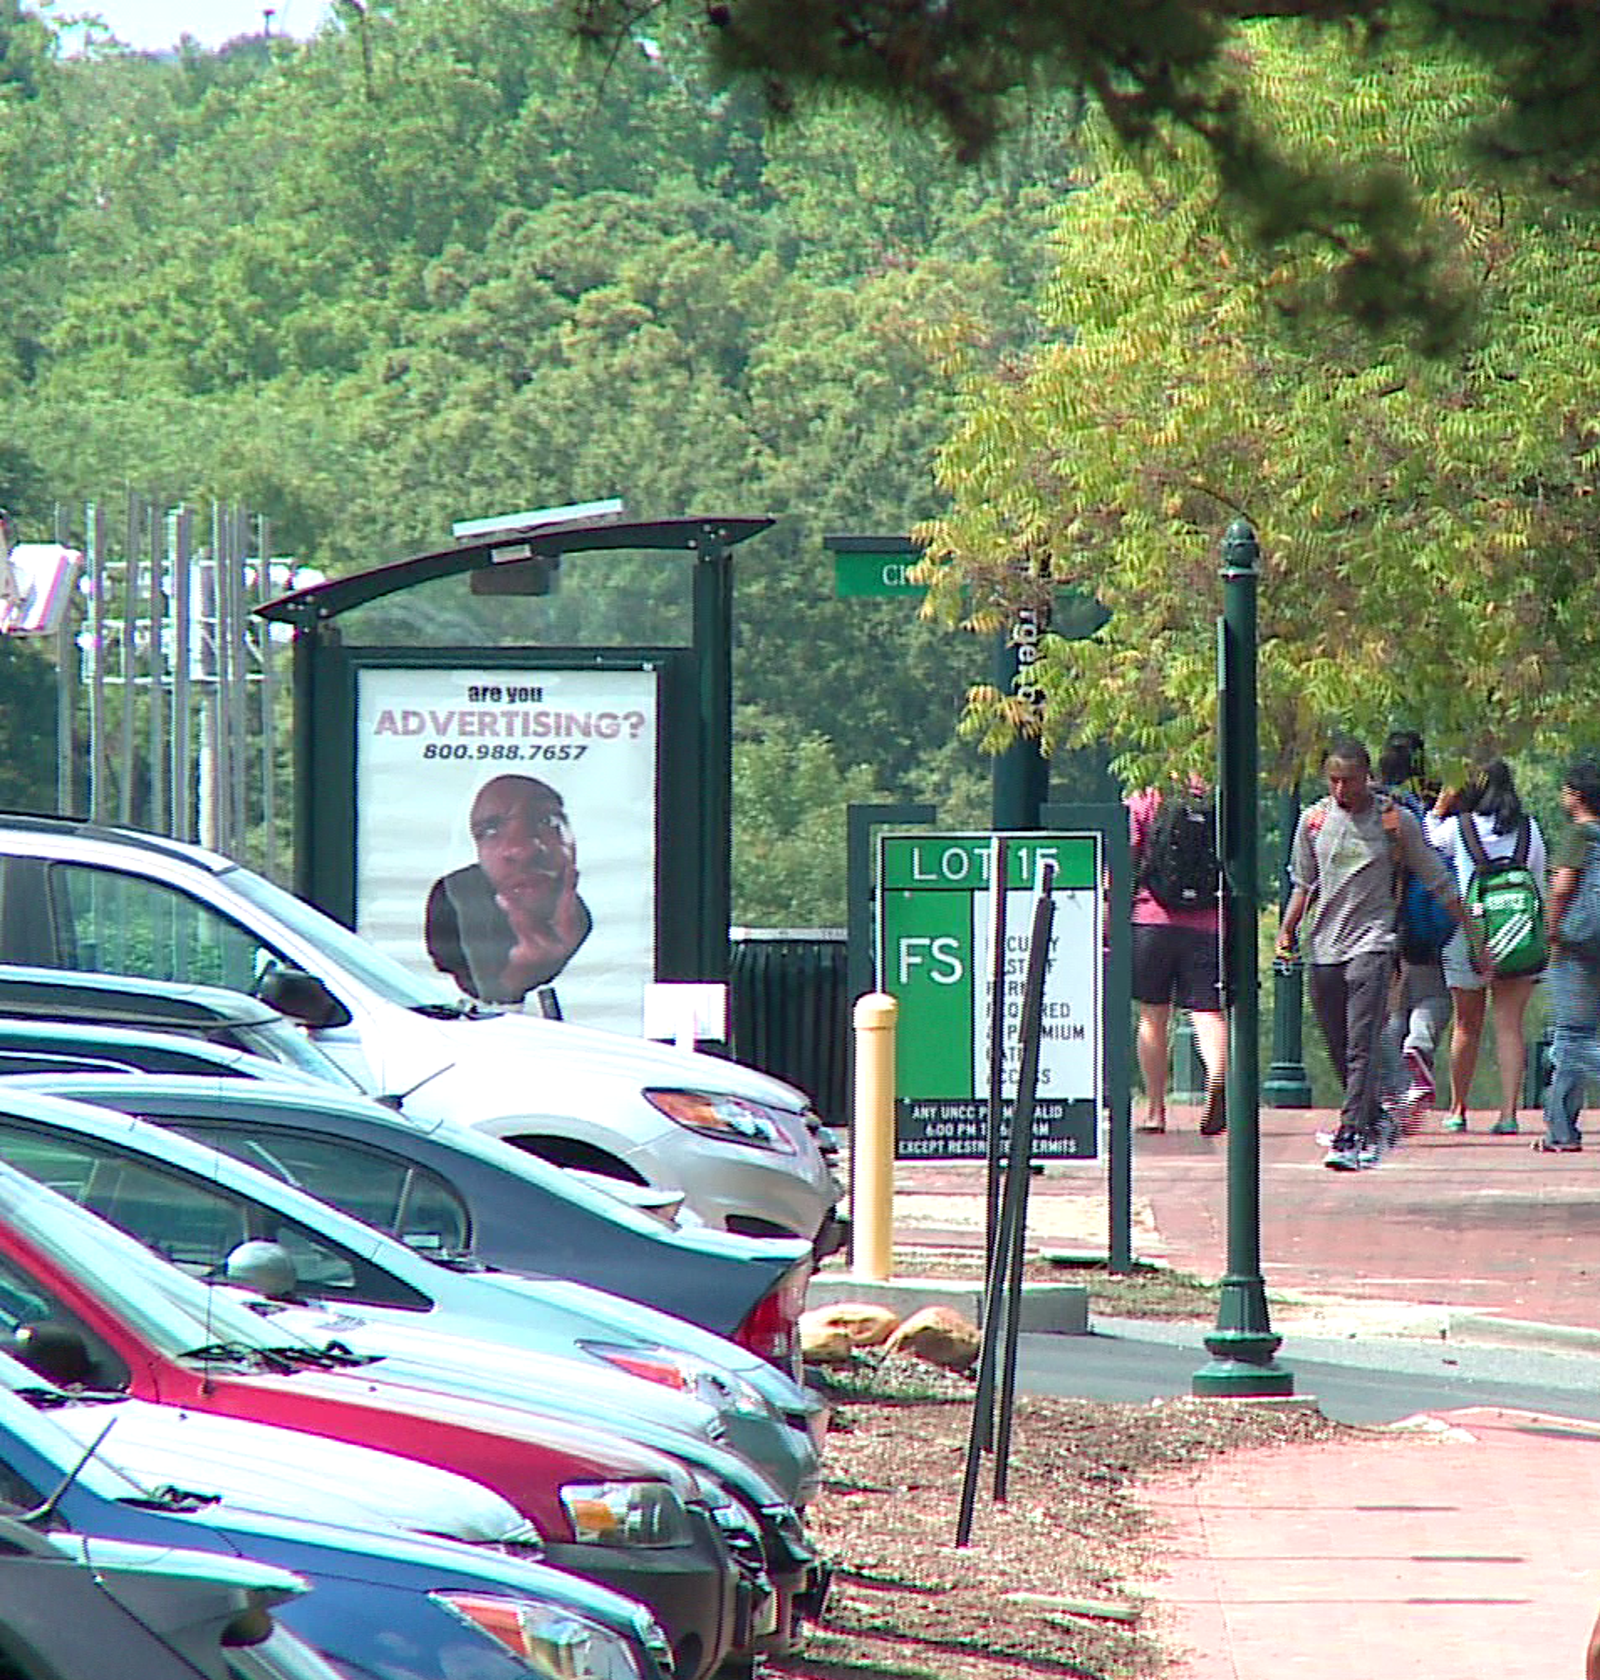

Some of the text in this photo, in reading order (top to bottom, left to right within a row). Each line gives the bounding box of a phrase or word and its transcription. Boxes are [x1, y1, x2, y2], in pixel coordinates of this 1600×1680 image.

[468, 686, 543, 704] are you
[373, 709, 646, 738] ADVERTISING?
[422, 744, 588, 761] 800.988.7657
[898, 936, 964, 985] FS
[1007, 1024, 1085, 1041] PMIUM
